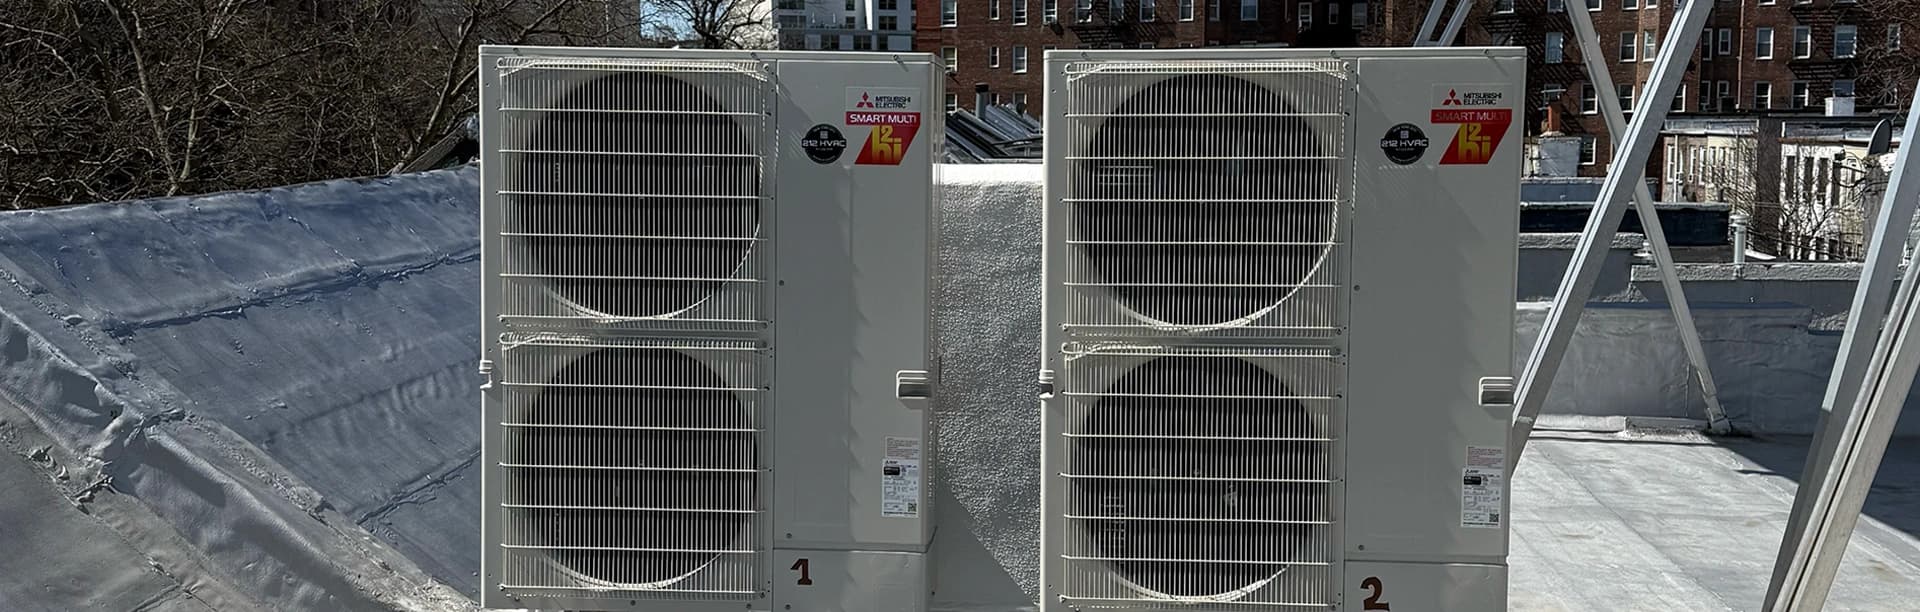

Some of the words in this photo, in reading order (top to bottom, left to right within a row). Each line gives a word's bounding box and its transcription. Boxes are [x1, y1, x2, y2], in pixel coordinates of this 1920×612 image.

[850, 114, 886, 123] SMART
[888, 114, 916, 123] MULTI
[1435, 112, 1473, 120] SMART
[1476, 112, 1507, 120] MULTI
[790, 558, 813, 586] 1
[1360, 576, 1390, 612] 2
